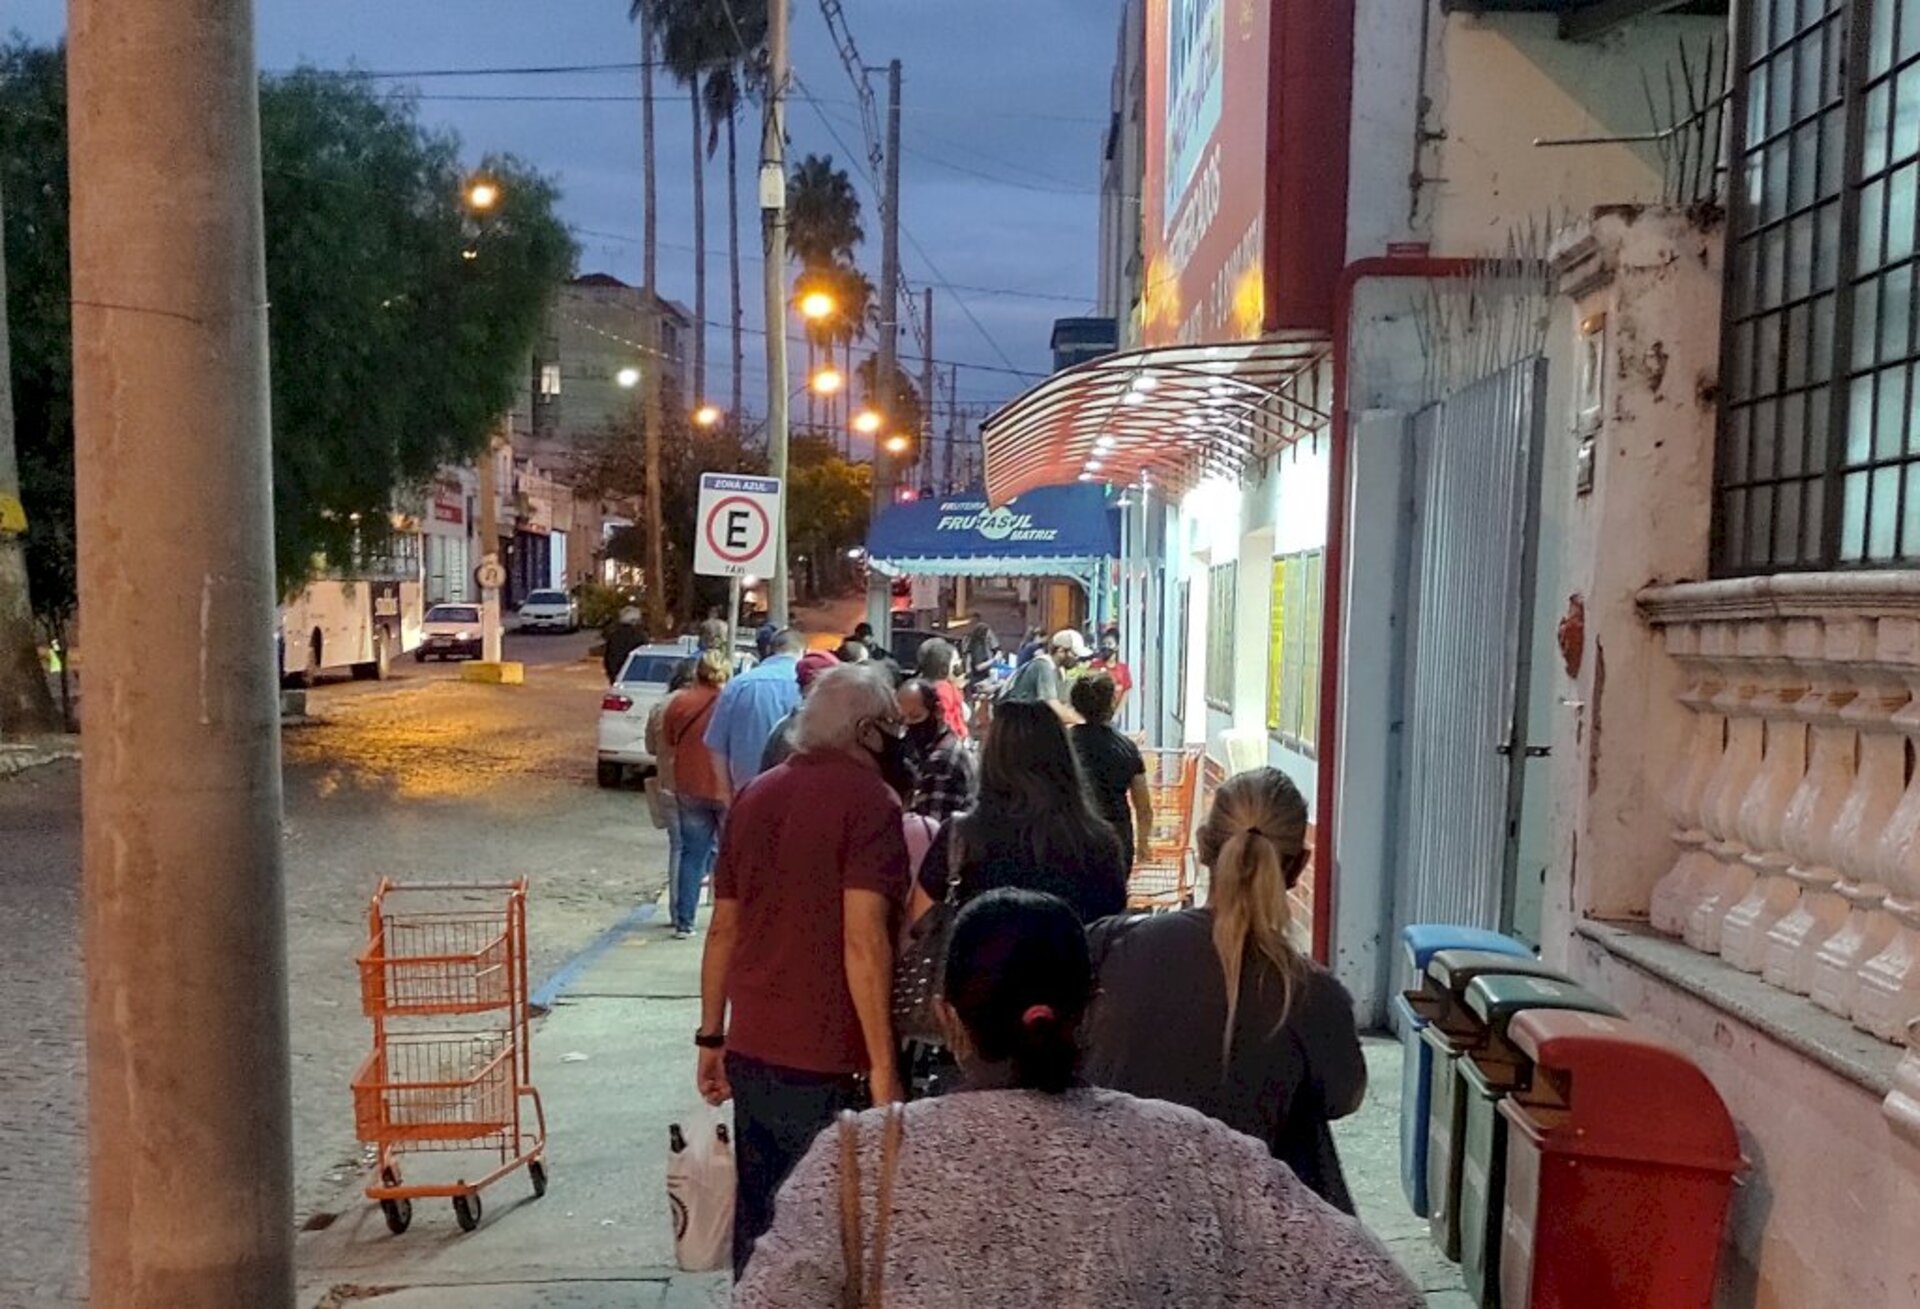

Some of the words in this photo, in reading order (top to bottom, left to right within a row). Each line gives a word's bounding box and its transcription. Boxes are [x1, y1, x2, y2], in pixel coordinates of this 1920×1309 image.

[714, 480, 741, 491] ZONA
[741, 482, 768, 492] AZUL
[726, 511, 750, 548] E
[937, 514, 1034, 531] FRUTASUL
[1009, 530, 1058, 541] MATRIZ
